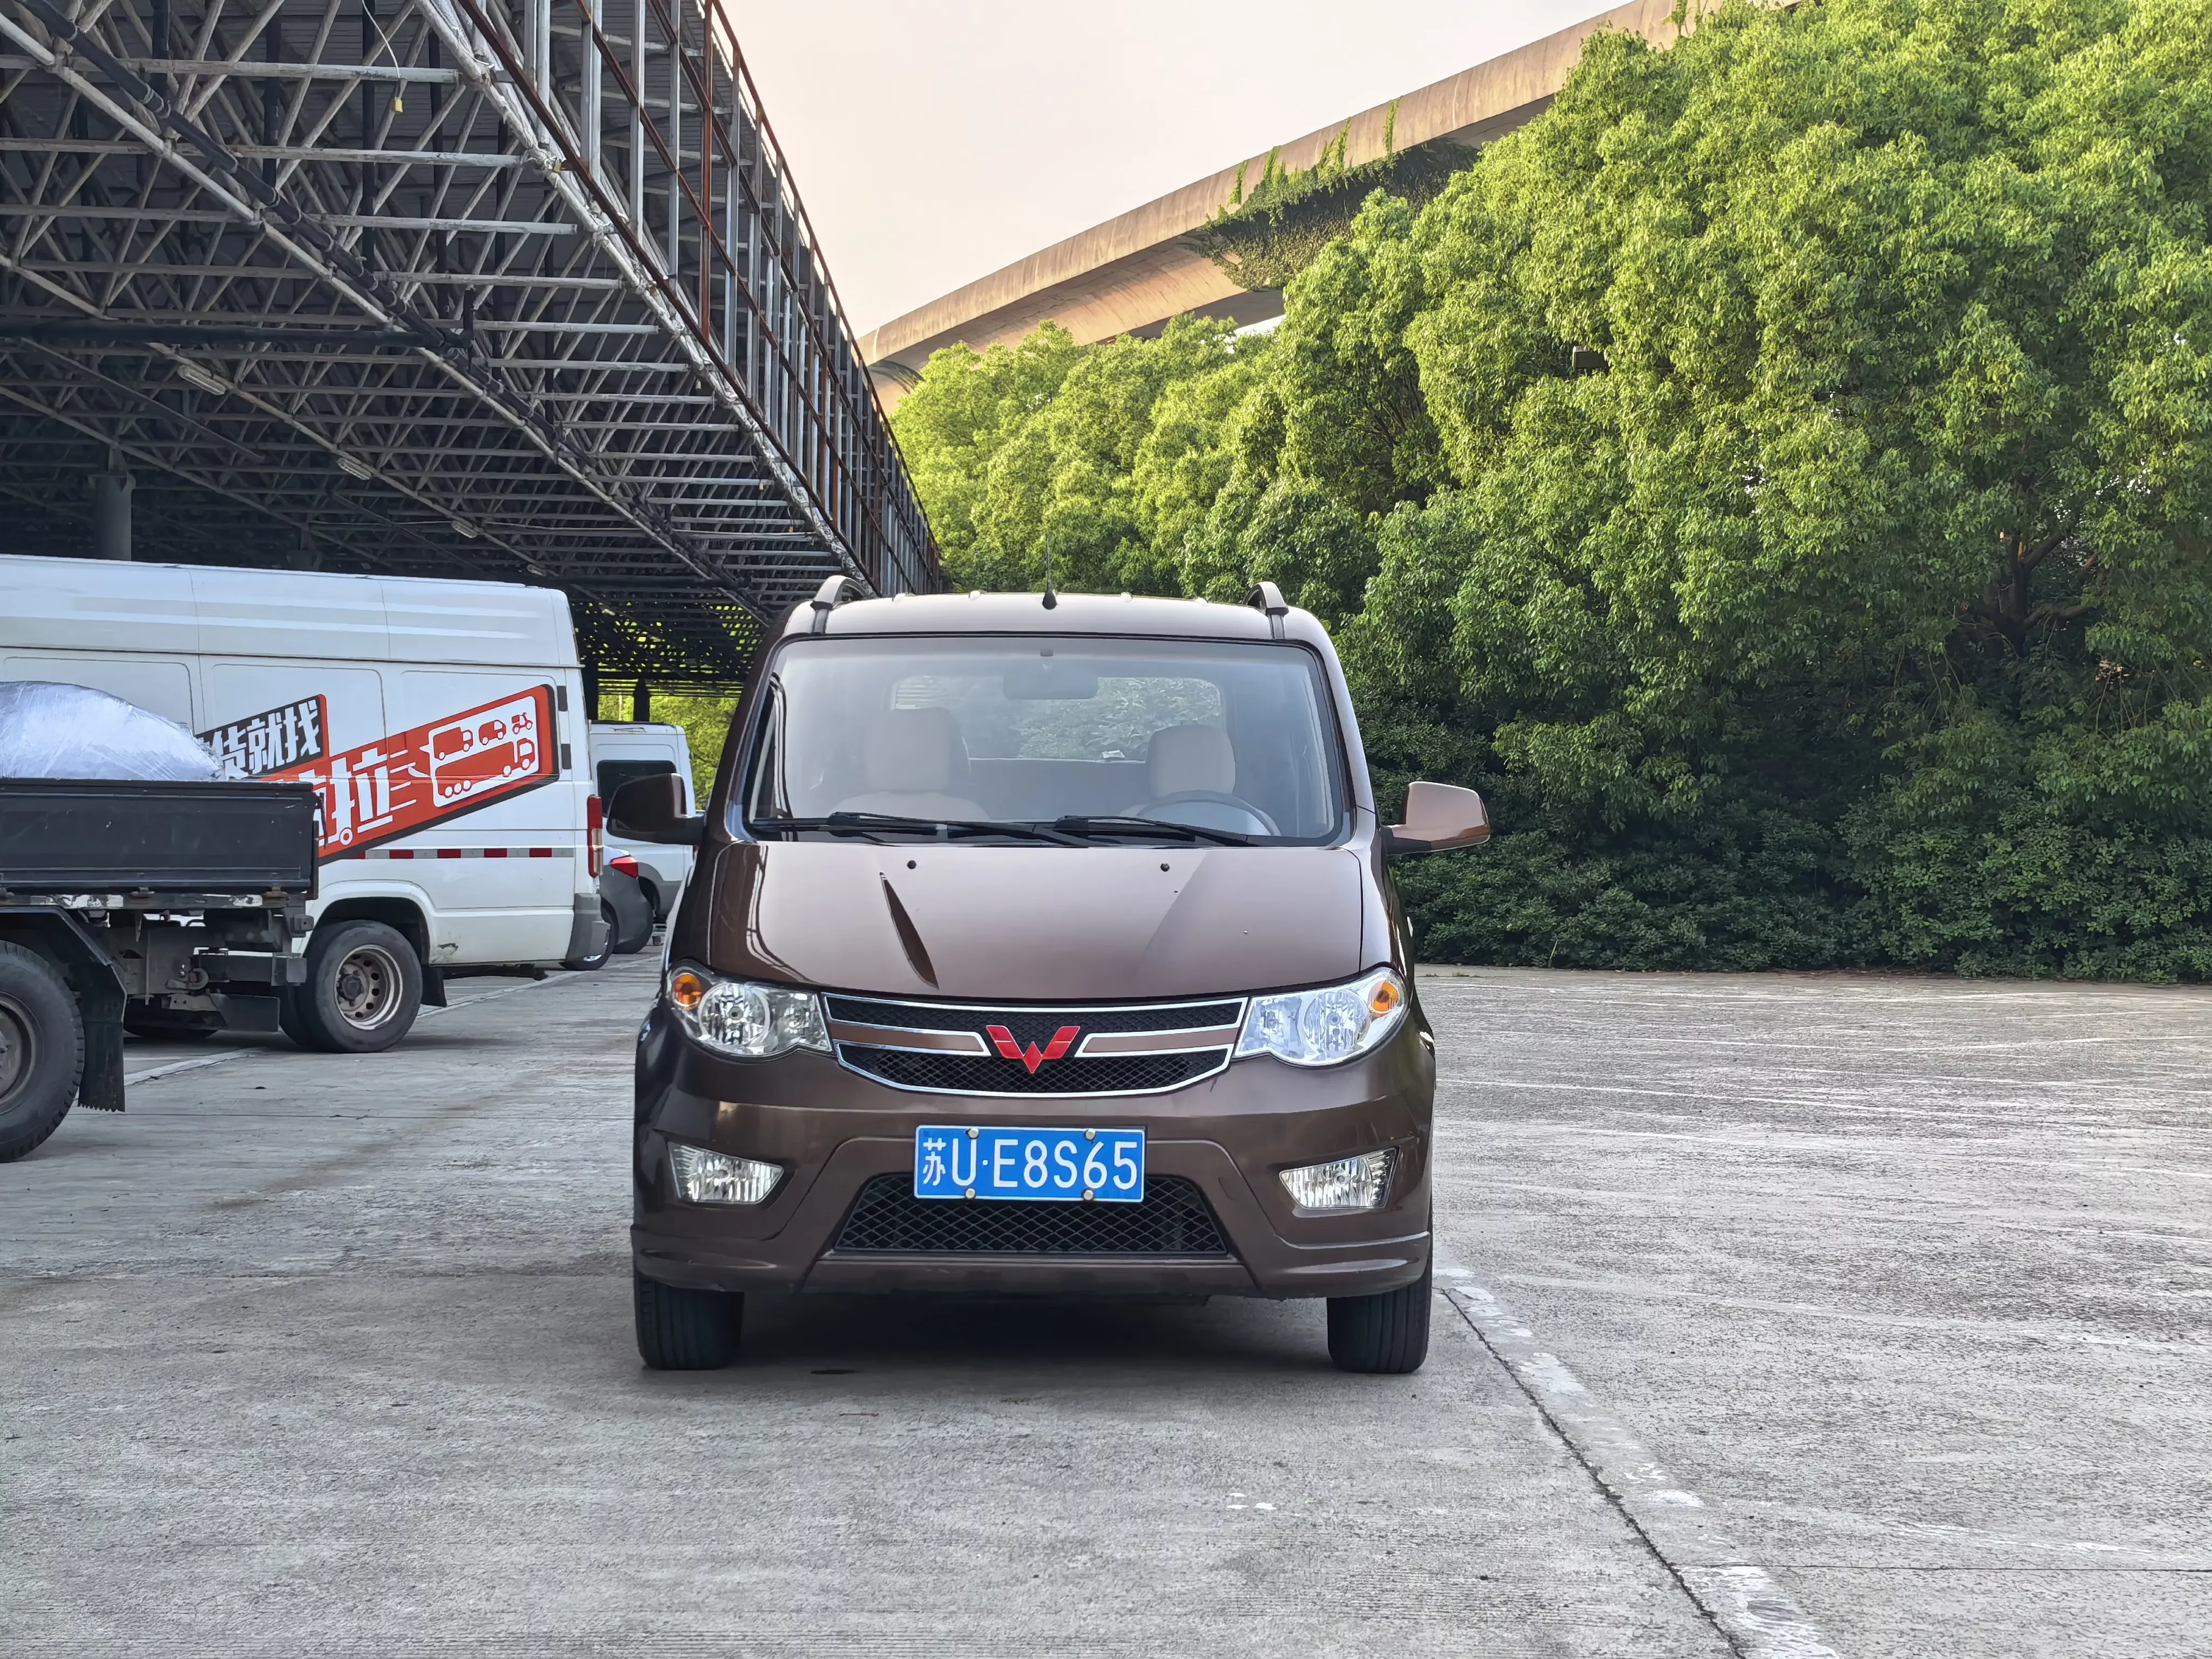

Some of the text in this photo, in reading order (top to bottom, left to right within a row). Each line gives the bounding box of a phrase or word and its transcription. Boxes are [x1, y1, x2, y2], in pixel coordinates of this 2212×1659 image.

[199, 699, 321, 781] 货就找
[922, 1138, 1137, 1190] 苏U·E8S65
